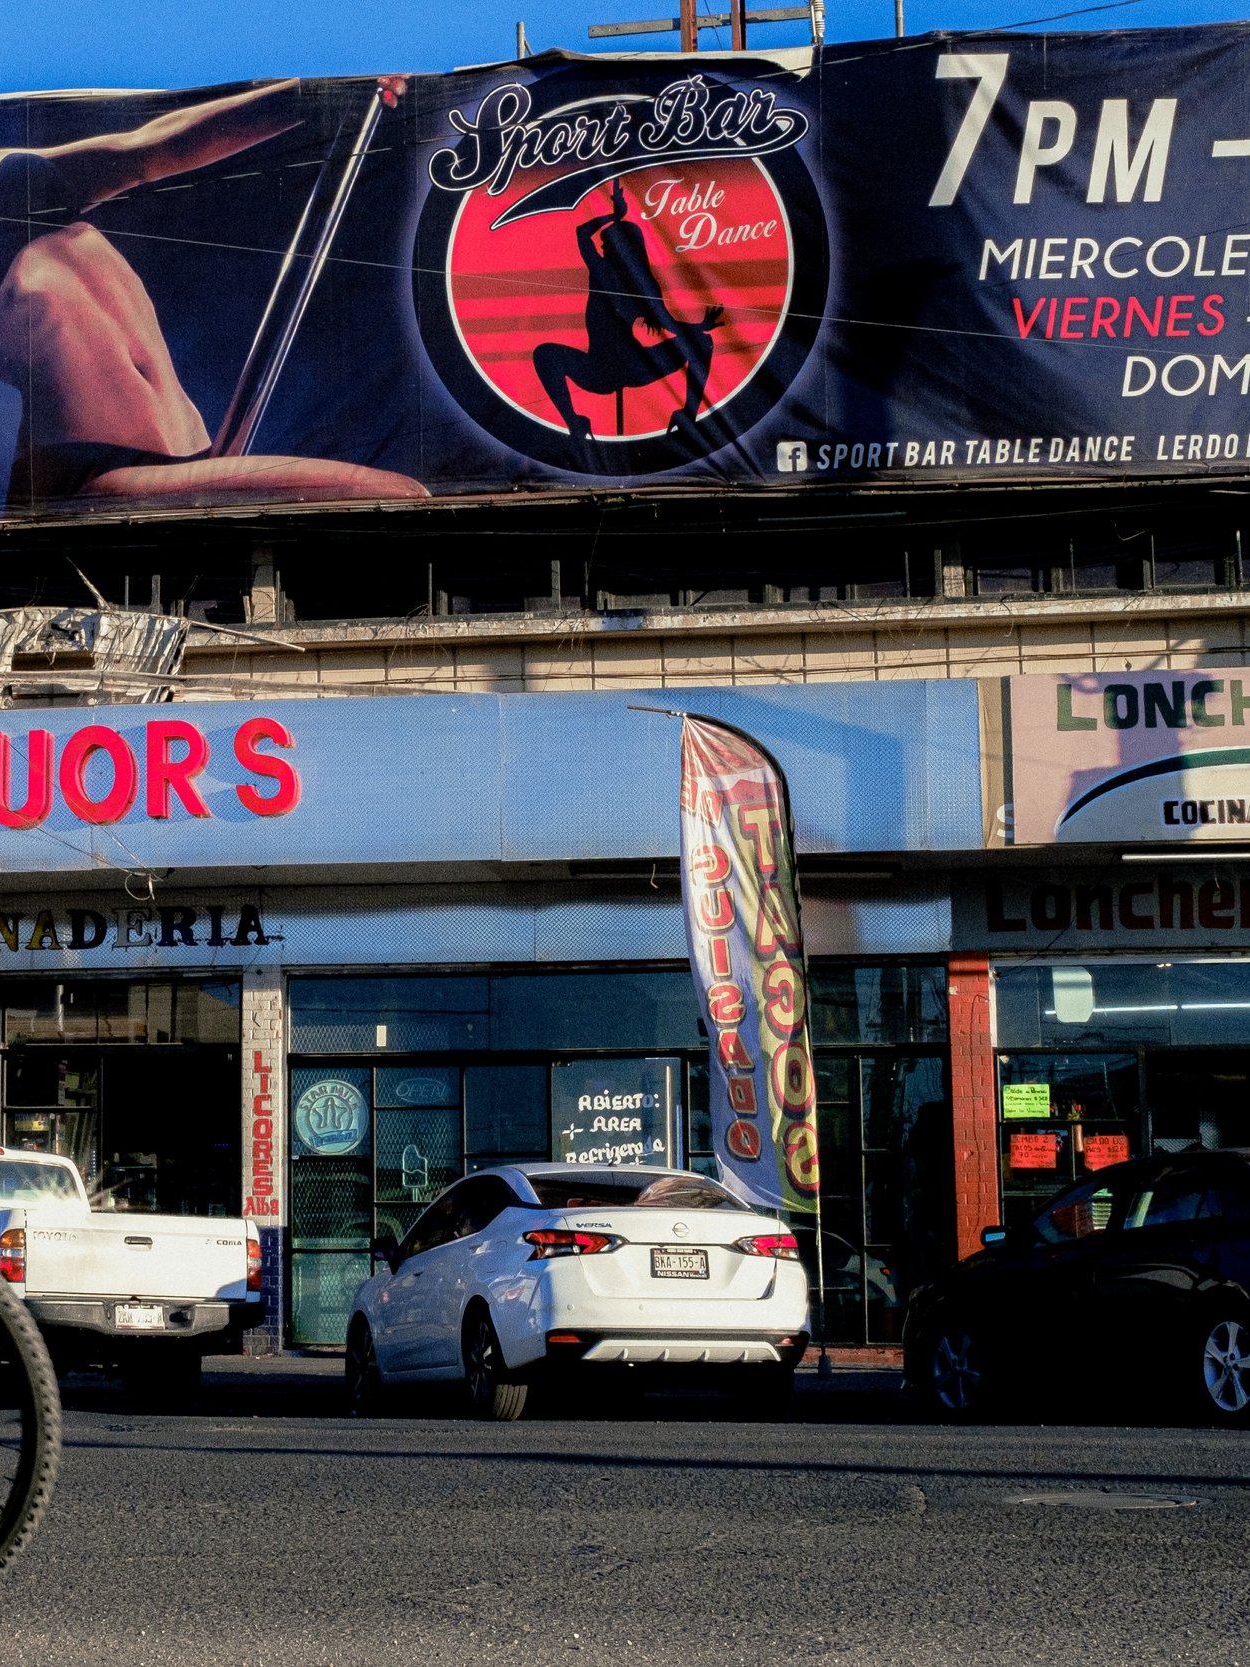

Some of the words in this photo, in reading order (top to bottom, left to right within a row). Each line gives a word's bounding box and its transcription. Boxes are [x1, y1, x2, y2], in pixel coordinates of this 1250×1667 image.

[429, 82, 631, 196] Sport
[639, 75, 780, 151] Bar
[641, 178, 725, 220] Table
[674, 211, 777, 252] Dance
[1010, 293, 1226, 341] VIERNES
[816, 441, 898, 470] SPORT
[904, 440, 957, 468] BAR
[965, 437, 1043, 465] TABLE
[1047, 435, 1135, 464] DANCE
[1156, 433, 1239, 461] LERDO
[1163, 799, 1250, 824] COCIN
[987, 873, 1250, 933] Lonche
[299, 1084, 328, 1111] STAR
[395, 1083, 446, 1097] OPEN
[252, 1050, 274, 1197] LICORES
[590, 1115, 642, 1133] AREA
[32, 1230, 78, 1241] TOYOTA
[206, 1238, 243, 1246] COMA
[654, 1256, 706, 1269] BKA-155-A
[657, 1270, 689, 1278] NISSAN
